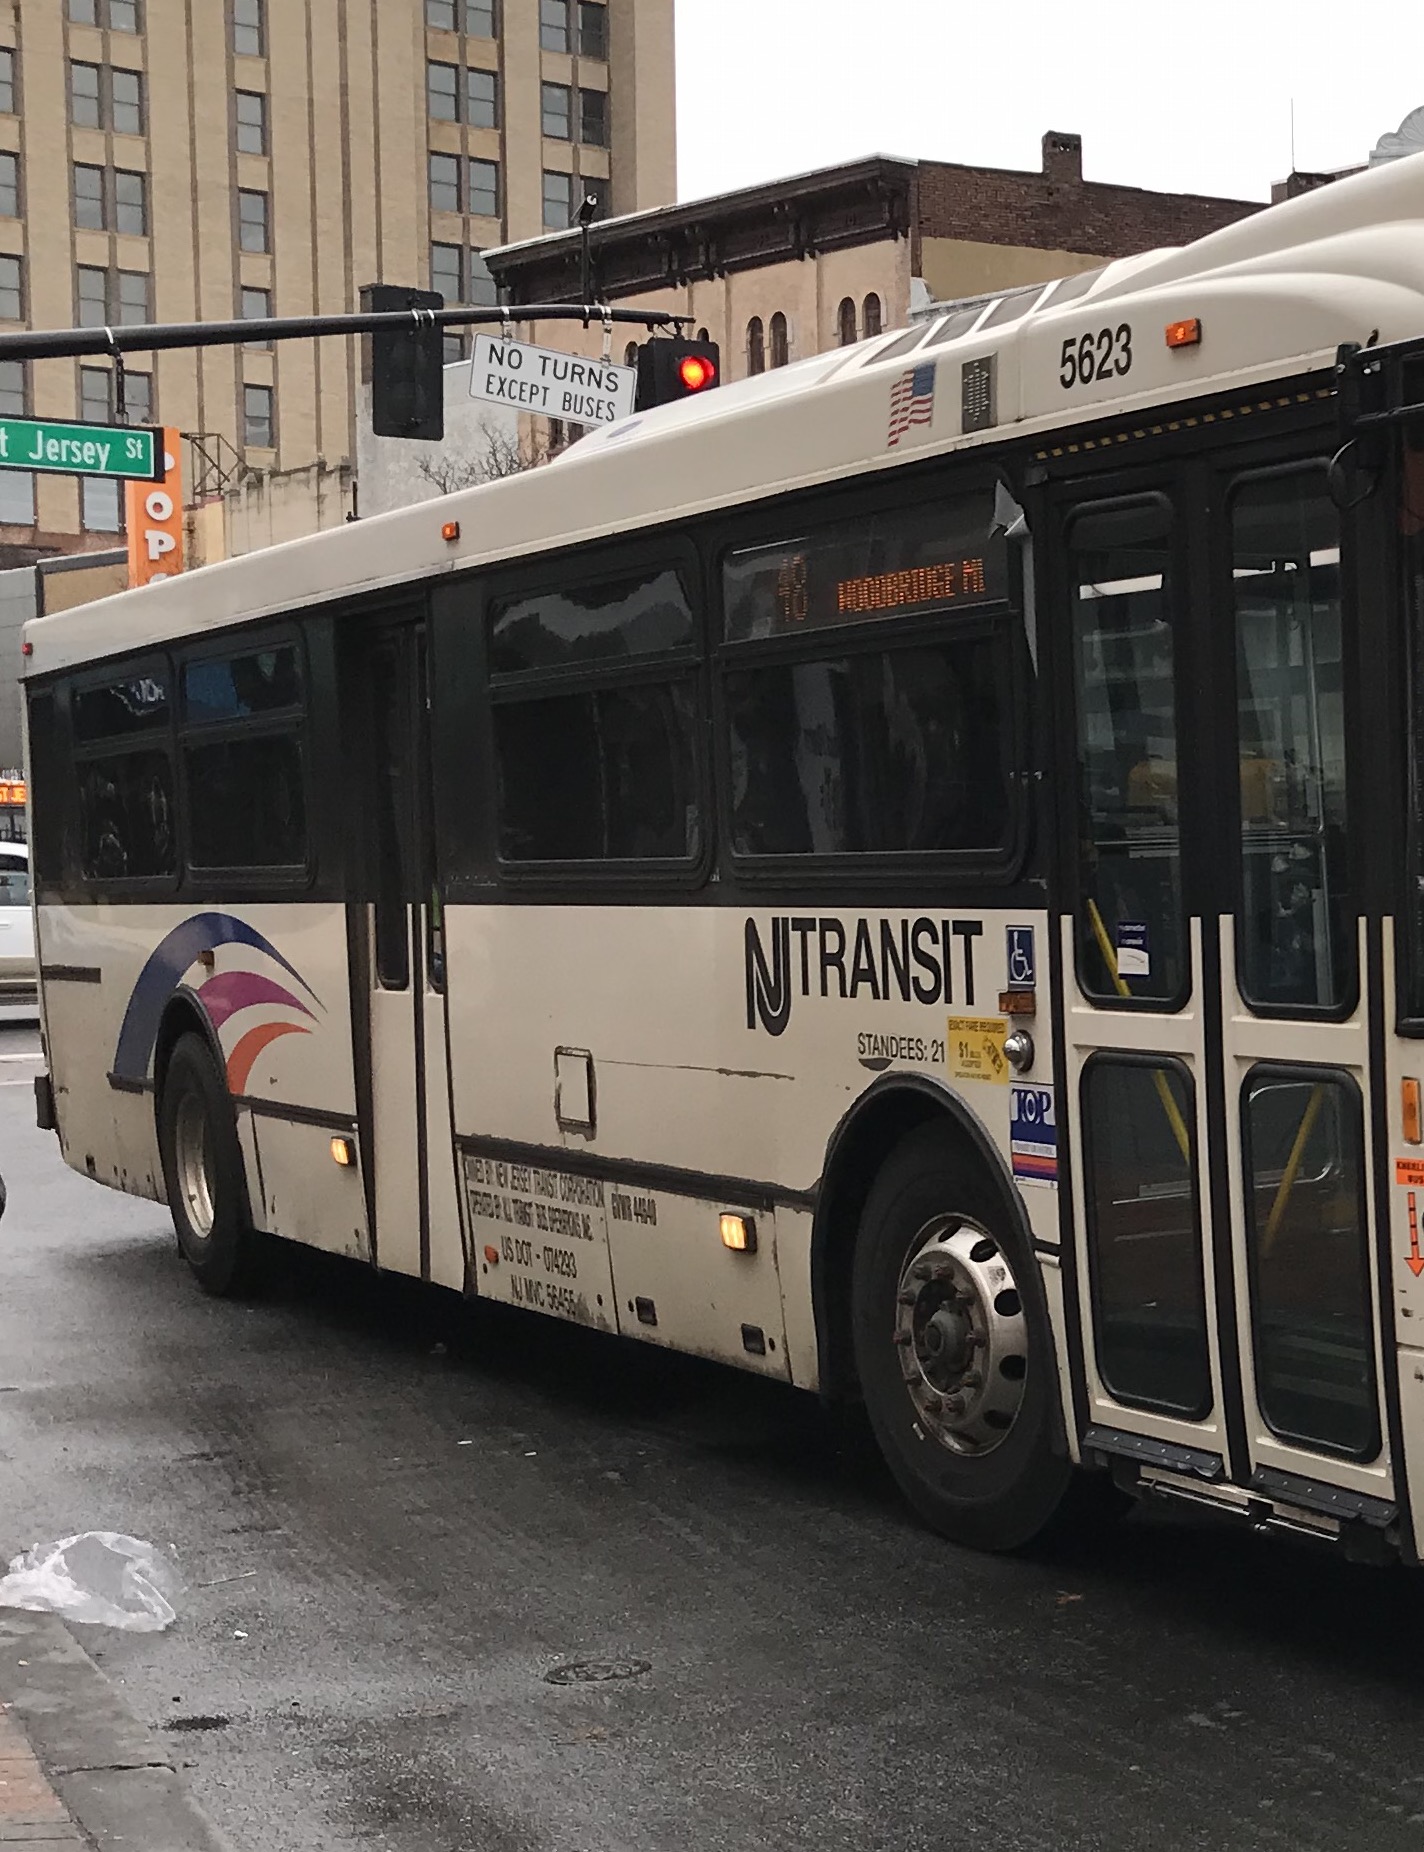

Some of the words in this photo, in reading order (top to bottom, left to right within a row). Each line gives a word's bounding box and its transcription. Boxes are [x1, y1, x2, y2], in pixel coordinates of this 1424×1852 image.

[488, 343, 523, 370] NO
[538, 354, 619, 393] TURNS
[1060, 323, 1132, 390] 5623
[485, 373, 551, 407] EXCEPT
[562, 391, 616, 422] BUSES
[28, 430, 111, 471] Jersey
[126, 437, 144, 460] St
[791, 916, 983, 1006] TRANSIT
[857, 1031, 928, 1063] STANDEES:
[931, 1039, 945, 1063] 21
[509, 1165, 531, 1193] JERSEY
[533, 1169, 558, 1200] TRANSIT
[559, 1172, 604, 1209] CORPORATION
[1408, 1175, 1424, 1185] BUS
[501, 1235, 514, 1262] US
[515, 1238, 533, 1268] DOT
[543, 1246, 577, 1279] 074293
[511, 1273, 523, 1301] NJ
[524, 1277, 545, 1307] MVC
[546, 1283, 577, 1317] 56455
